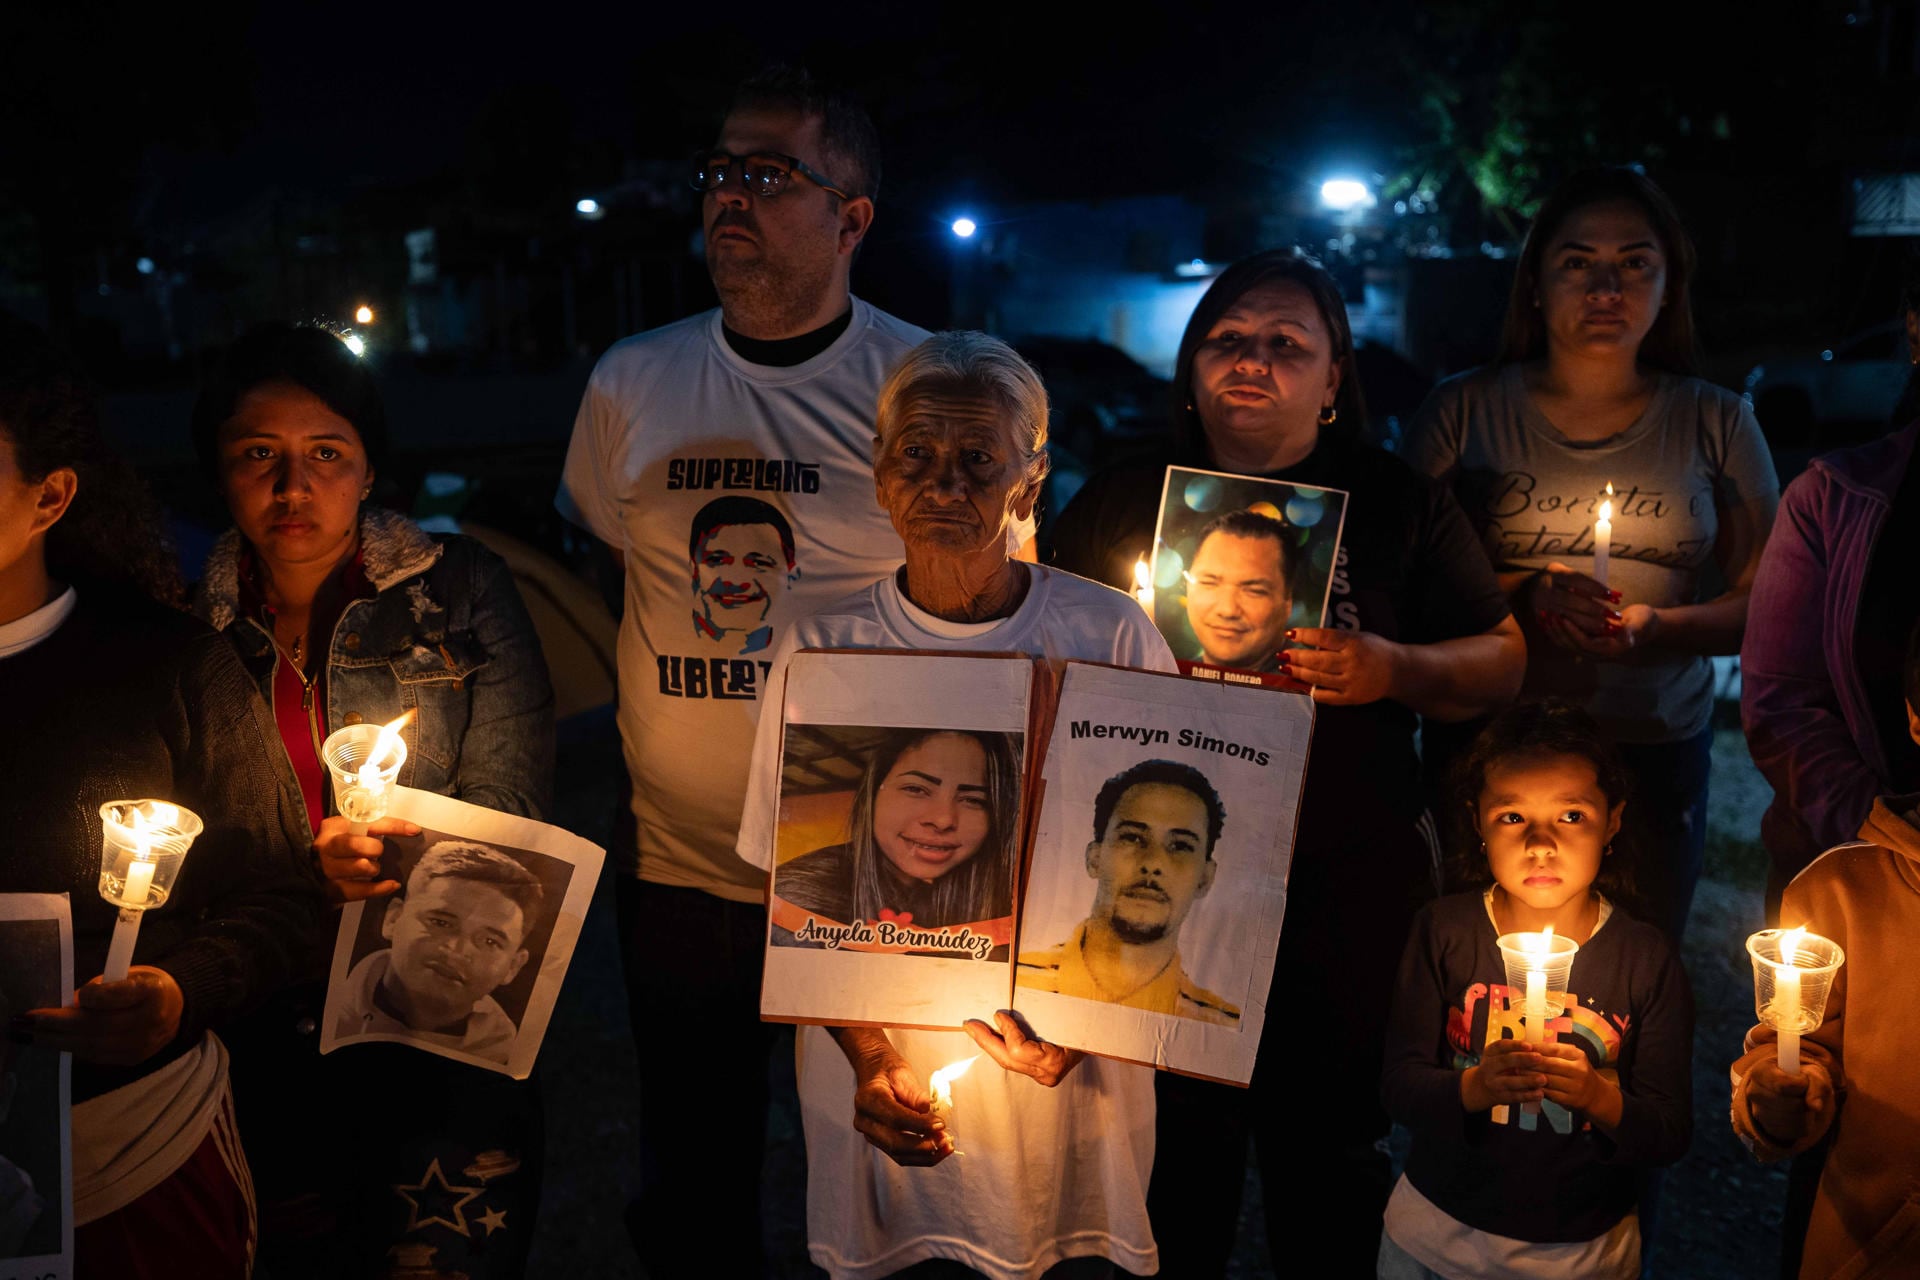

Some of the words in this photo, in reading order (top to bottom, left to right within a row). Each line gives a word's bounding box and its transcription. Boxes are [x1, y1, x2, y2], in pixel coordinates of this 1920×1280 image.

[1070, 720, 1169, 746] Merwyn
[1177, 729, 1270, 766] Simons
[797, 919, 874, 949] Anyela
[878, 923, 992, 959] Bermúdez
